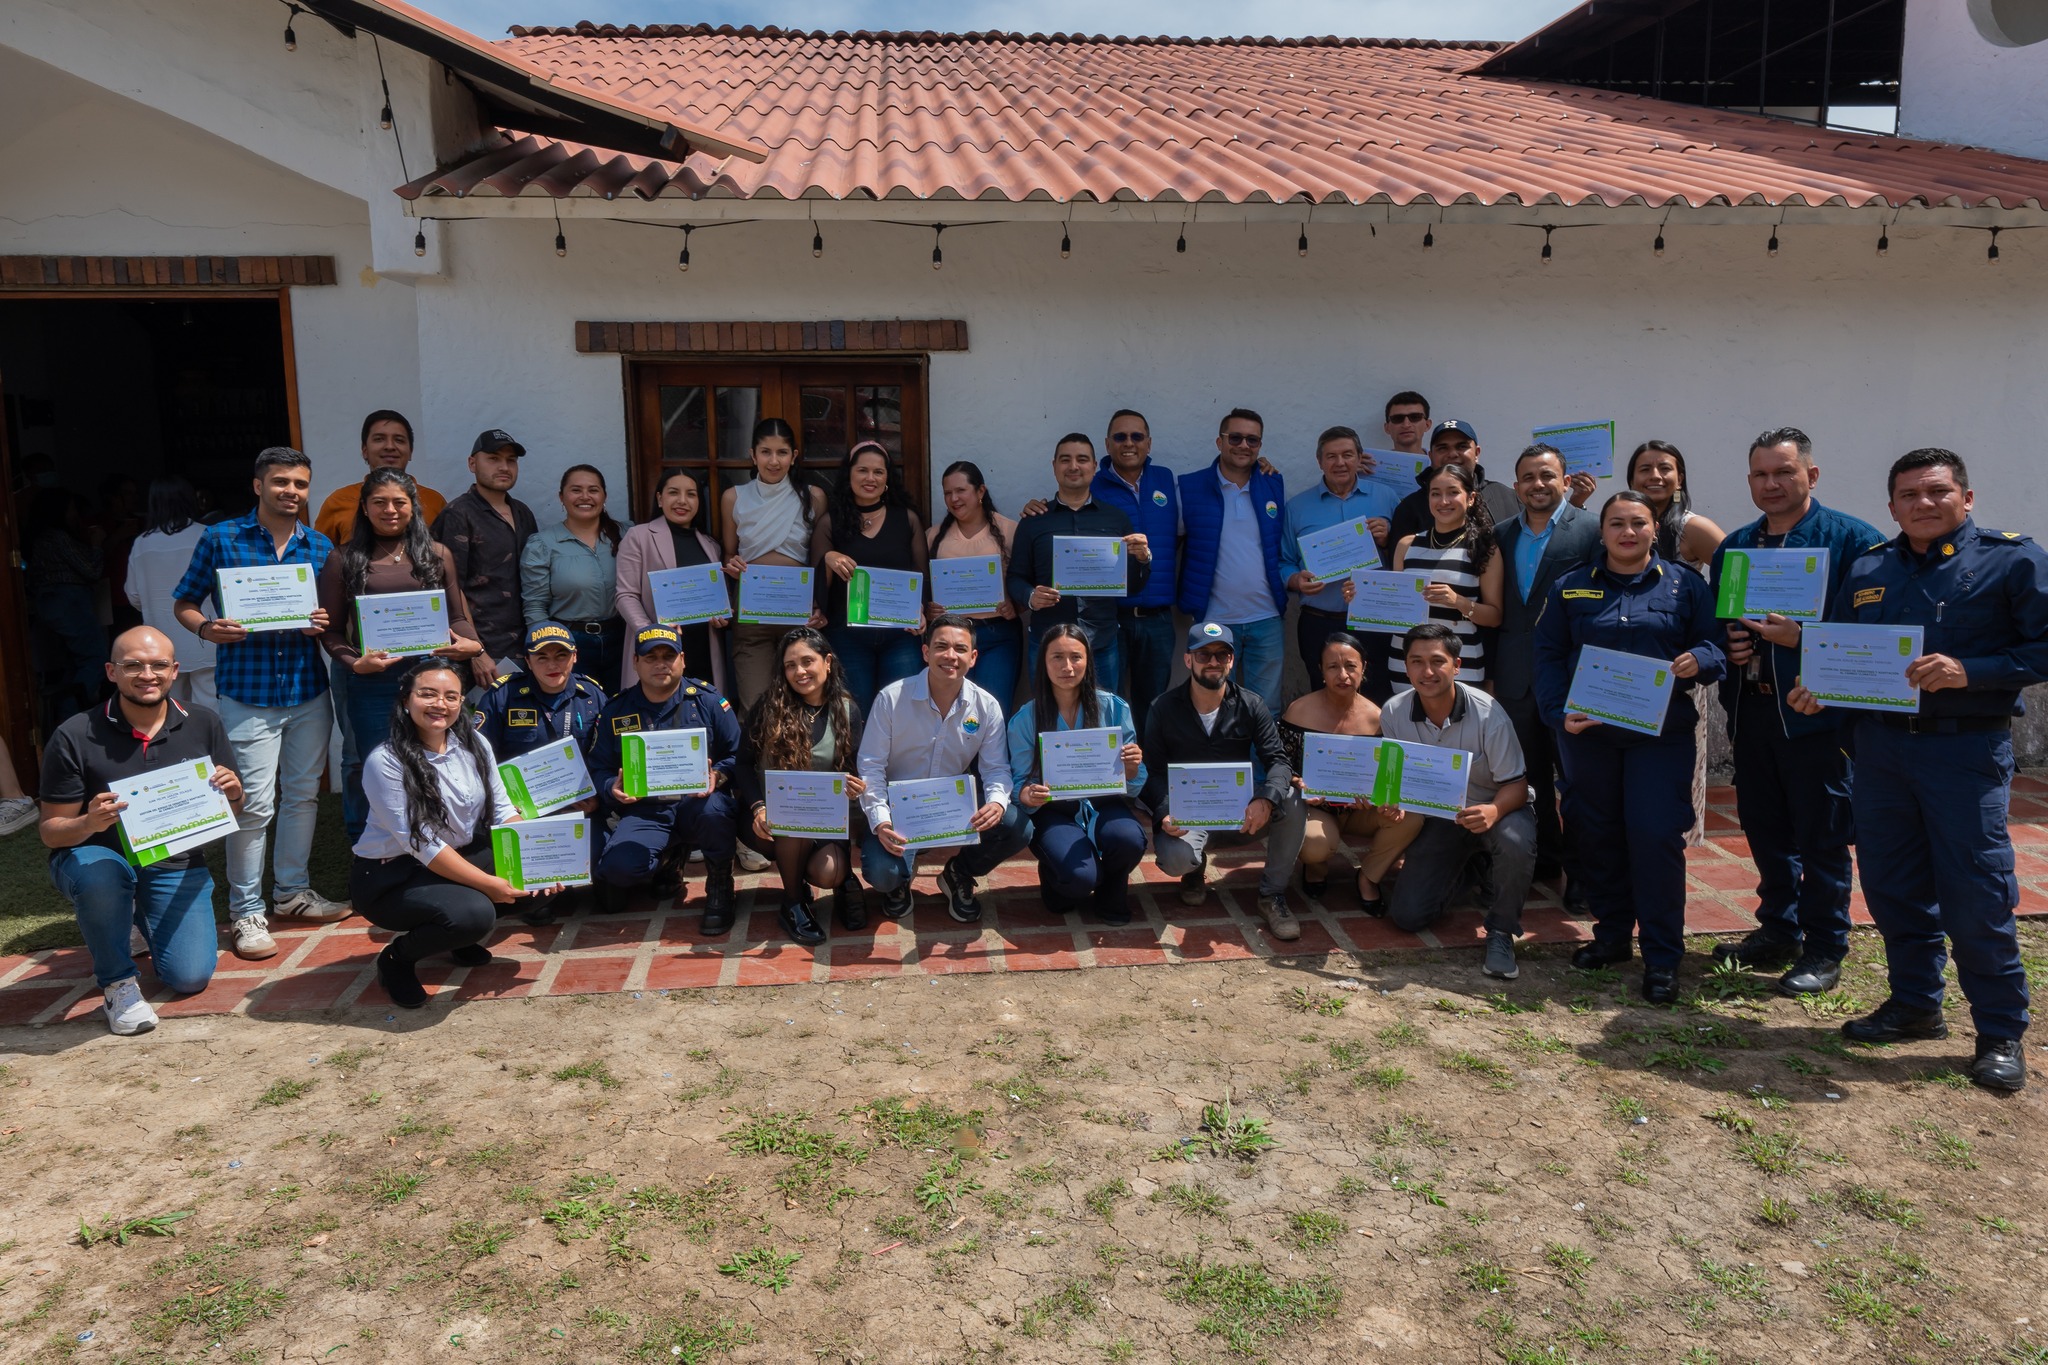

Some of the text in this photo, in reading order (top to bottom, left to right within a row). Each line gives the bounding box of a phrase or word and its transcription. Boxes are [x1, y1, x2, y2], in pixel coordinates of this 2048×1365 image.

[1443, 420, 1458, 429] H
[531, 626, 570, 642] BOMBEROS
[638, 628, 677, 642] BOMBEROS
